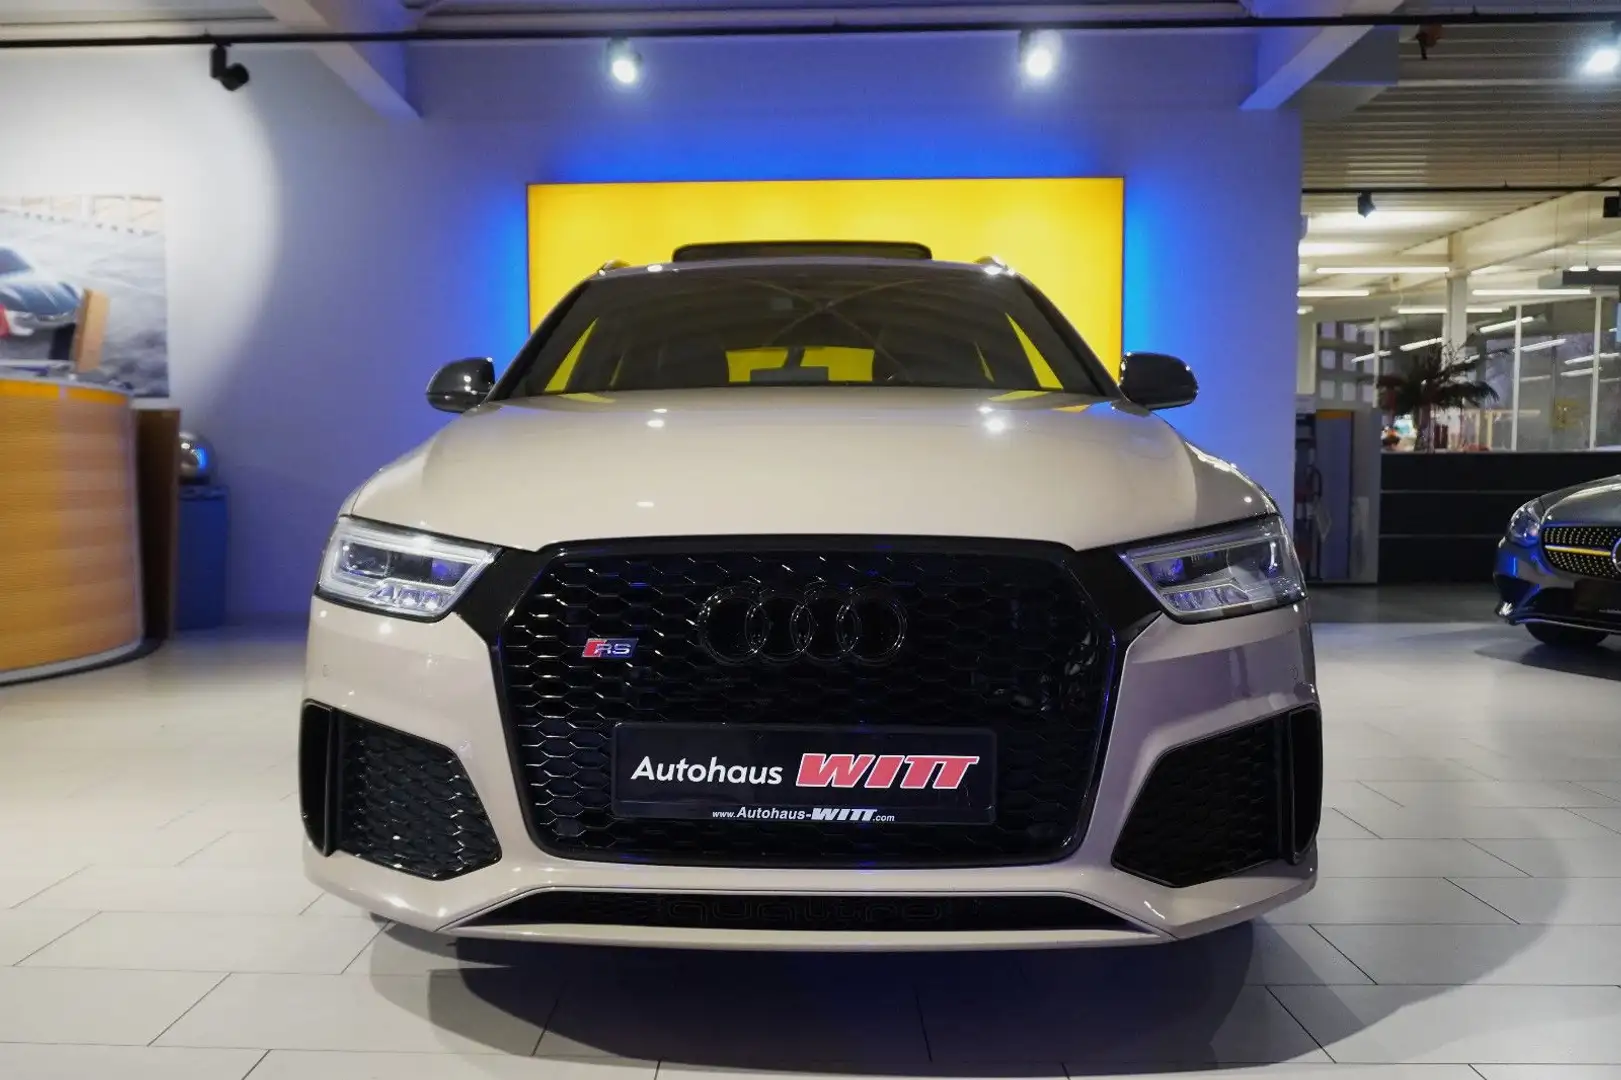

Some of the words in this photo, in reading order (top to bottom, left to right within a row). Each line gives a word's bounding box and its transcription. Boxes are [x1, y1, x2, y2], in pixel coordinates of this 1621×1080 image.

[594, 643, 631, 655] RS
[631, 756, 783, 785] Autohaus
[795, 753, 979, 789] WITT
[712, 806, 895, 822] www.Autohaus-WITT.com
